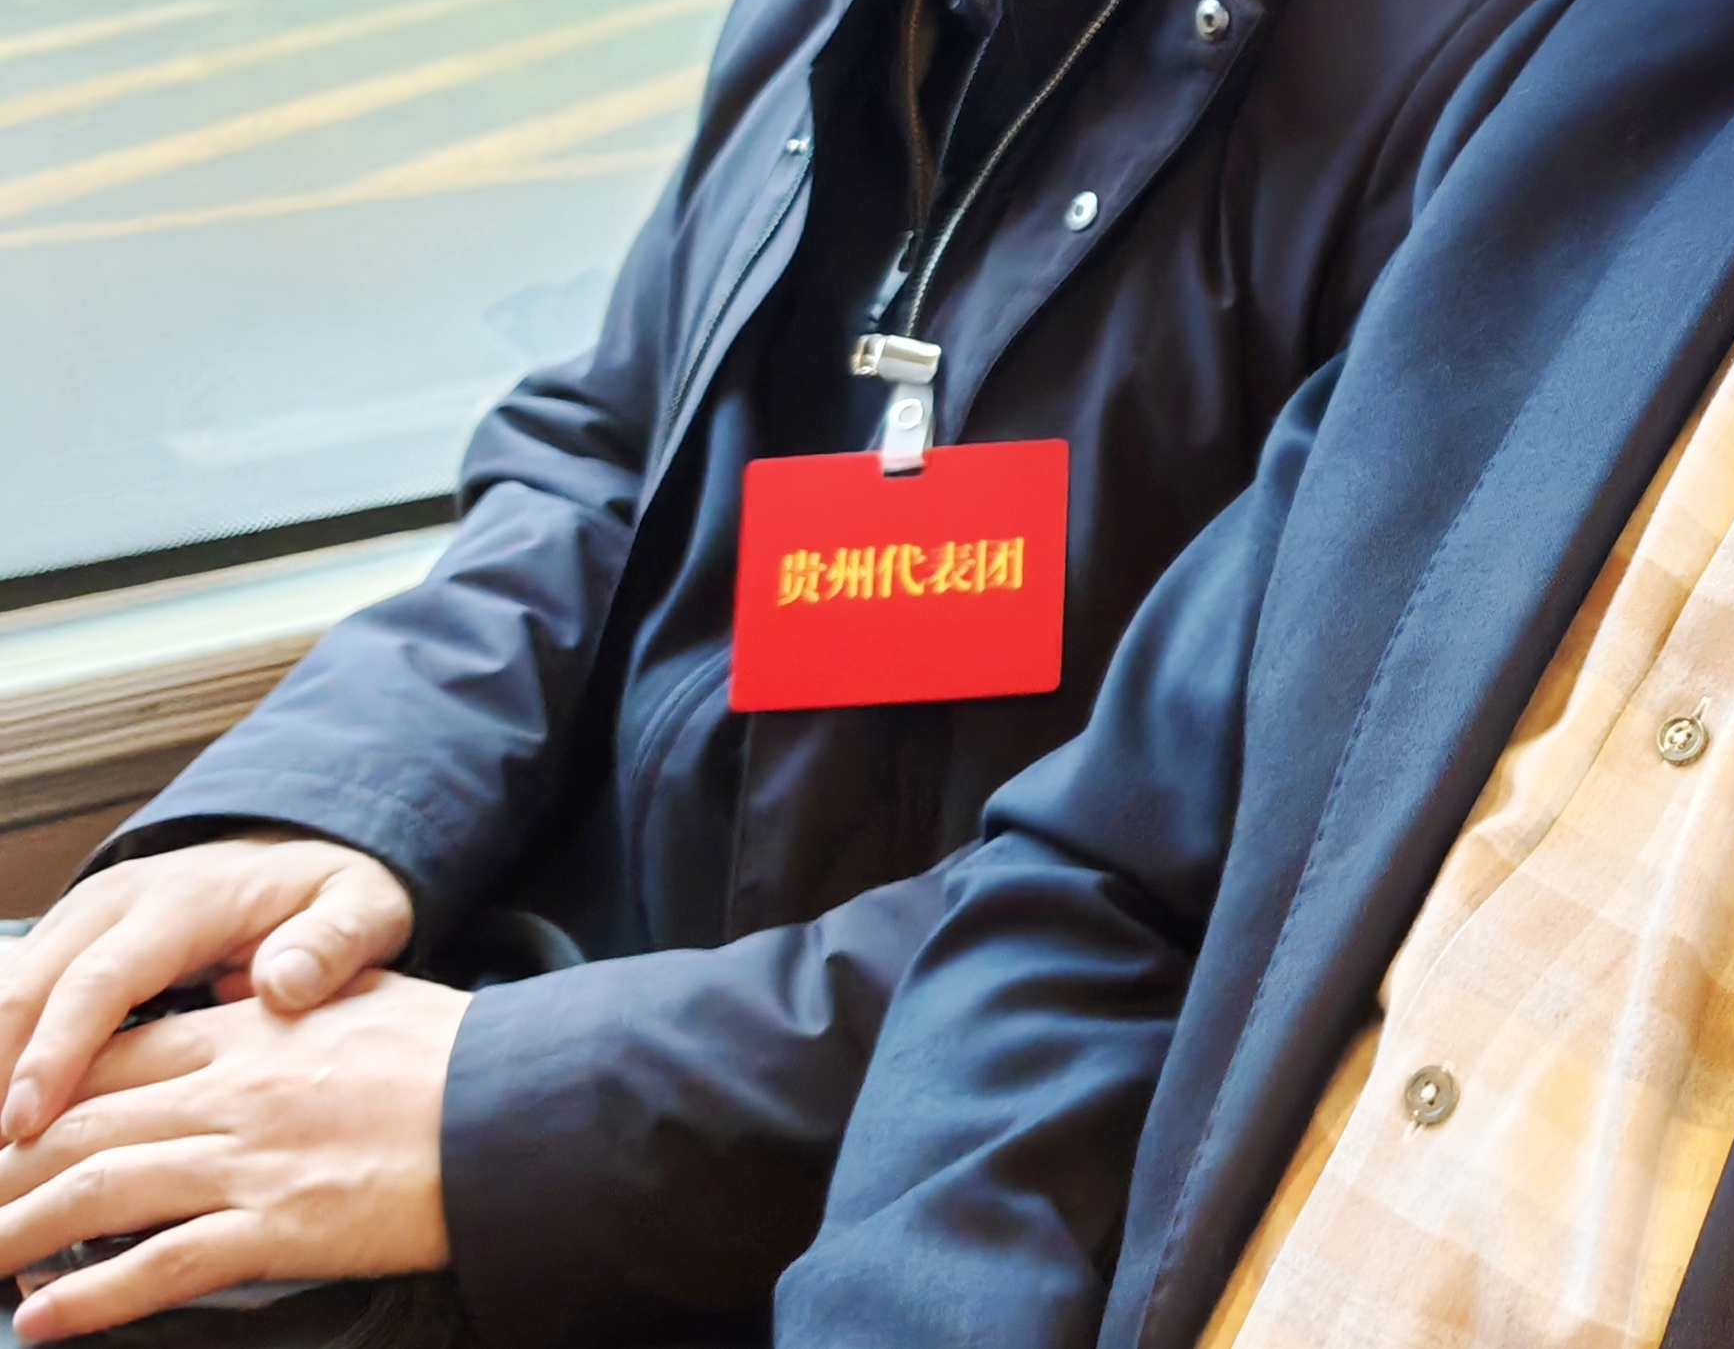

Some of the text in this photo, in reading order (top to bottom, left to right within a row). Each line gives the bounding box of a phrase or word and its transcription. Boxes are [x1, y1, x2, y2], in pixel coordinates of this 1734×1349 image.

[776, 535, 1025, 608] 贵州代表团
